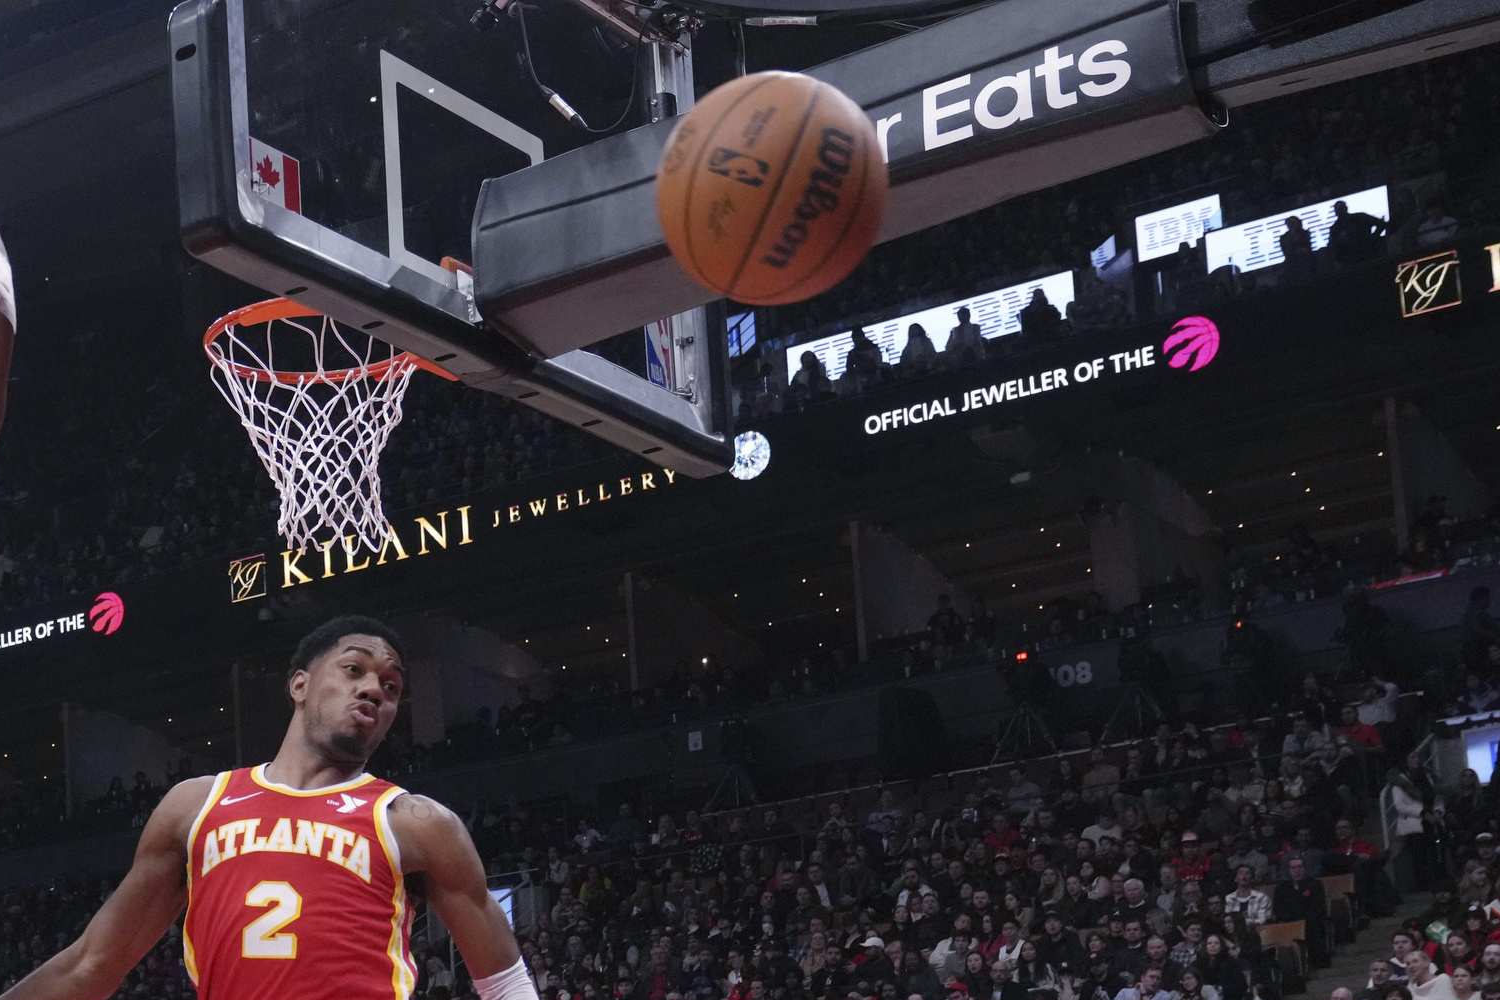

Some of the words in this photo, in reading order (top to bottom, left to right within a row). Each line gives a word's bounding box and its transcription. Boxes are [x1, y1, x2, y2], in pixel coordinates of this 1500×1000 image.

[923, 39, 1132, 152] Eats
[1144, 206, 1212, 251] IBM
[952, 283, 1044, 337] BM
[864, 397, 956, 434] OFFICIAL
[961, 368, 1069, 412] JEWELLER
[1073, 358, 1104, 383] OF
[1109, 345, 1155, 373] THE
[280, 505, 474, 589] KILANI
[492, 467, 676, 528] JEWELLERY
[35, 620, 55, 639] OF
[57, 613, 86, 634] THE
[326, 799, 340, 807] the
[202, 817, 372, 884] ATLANTA
[241, 880, 303, 959] 2
